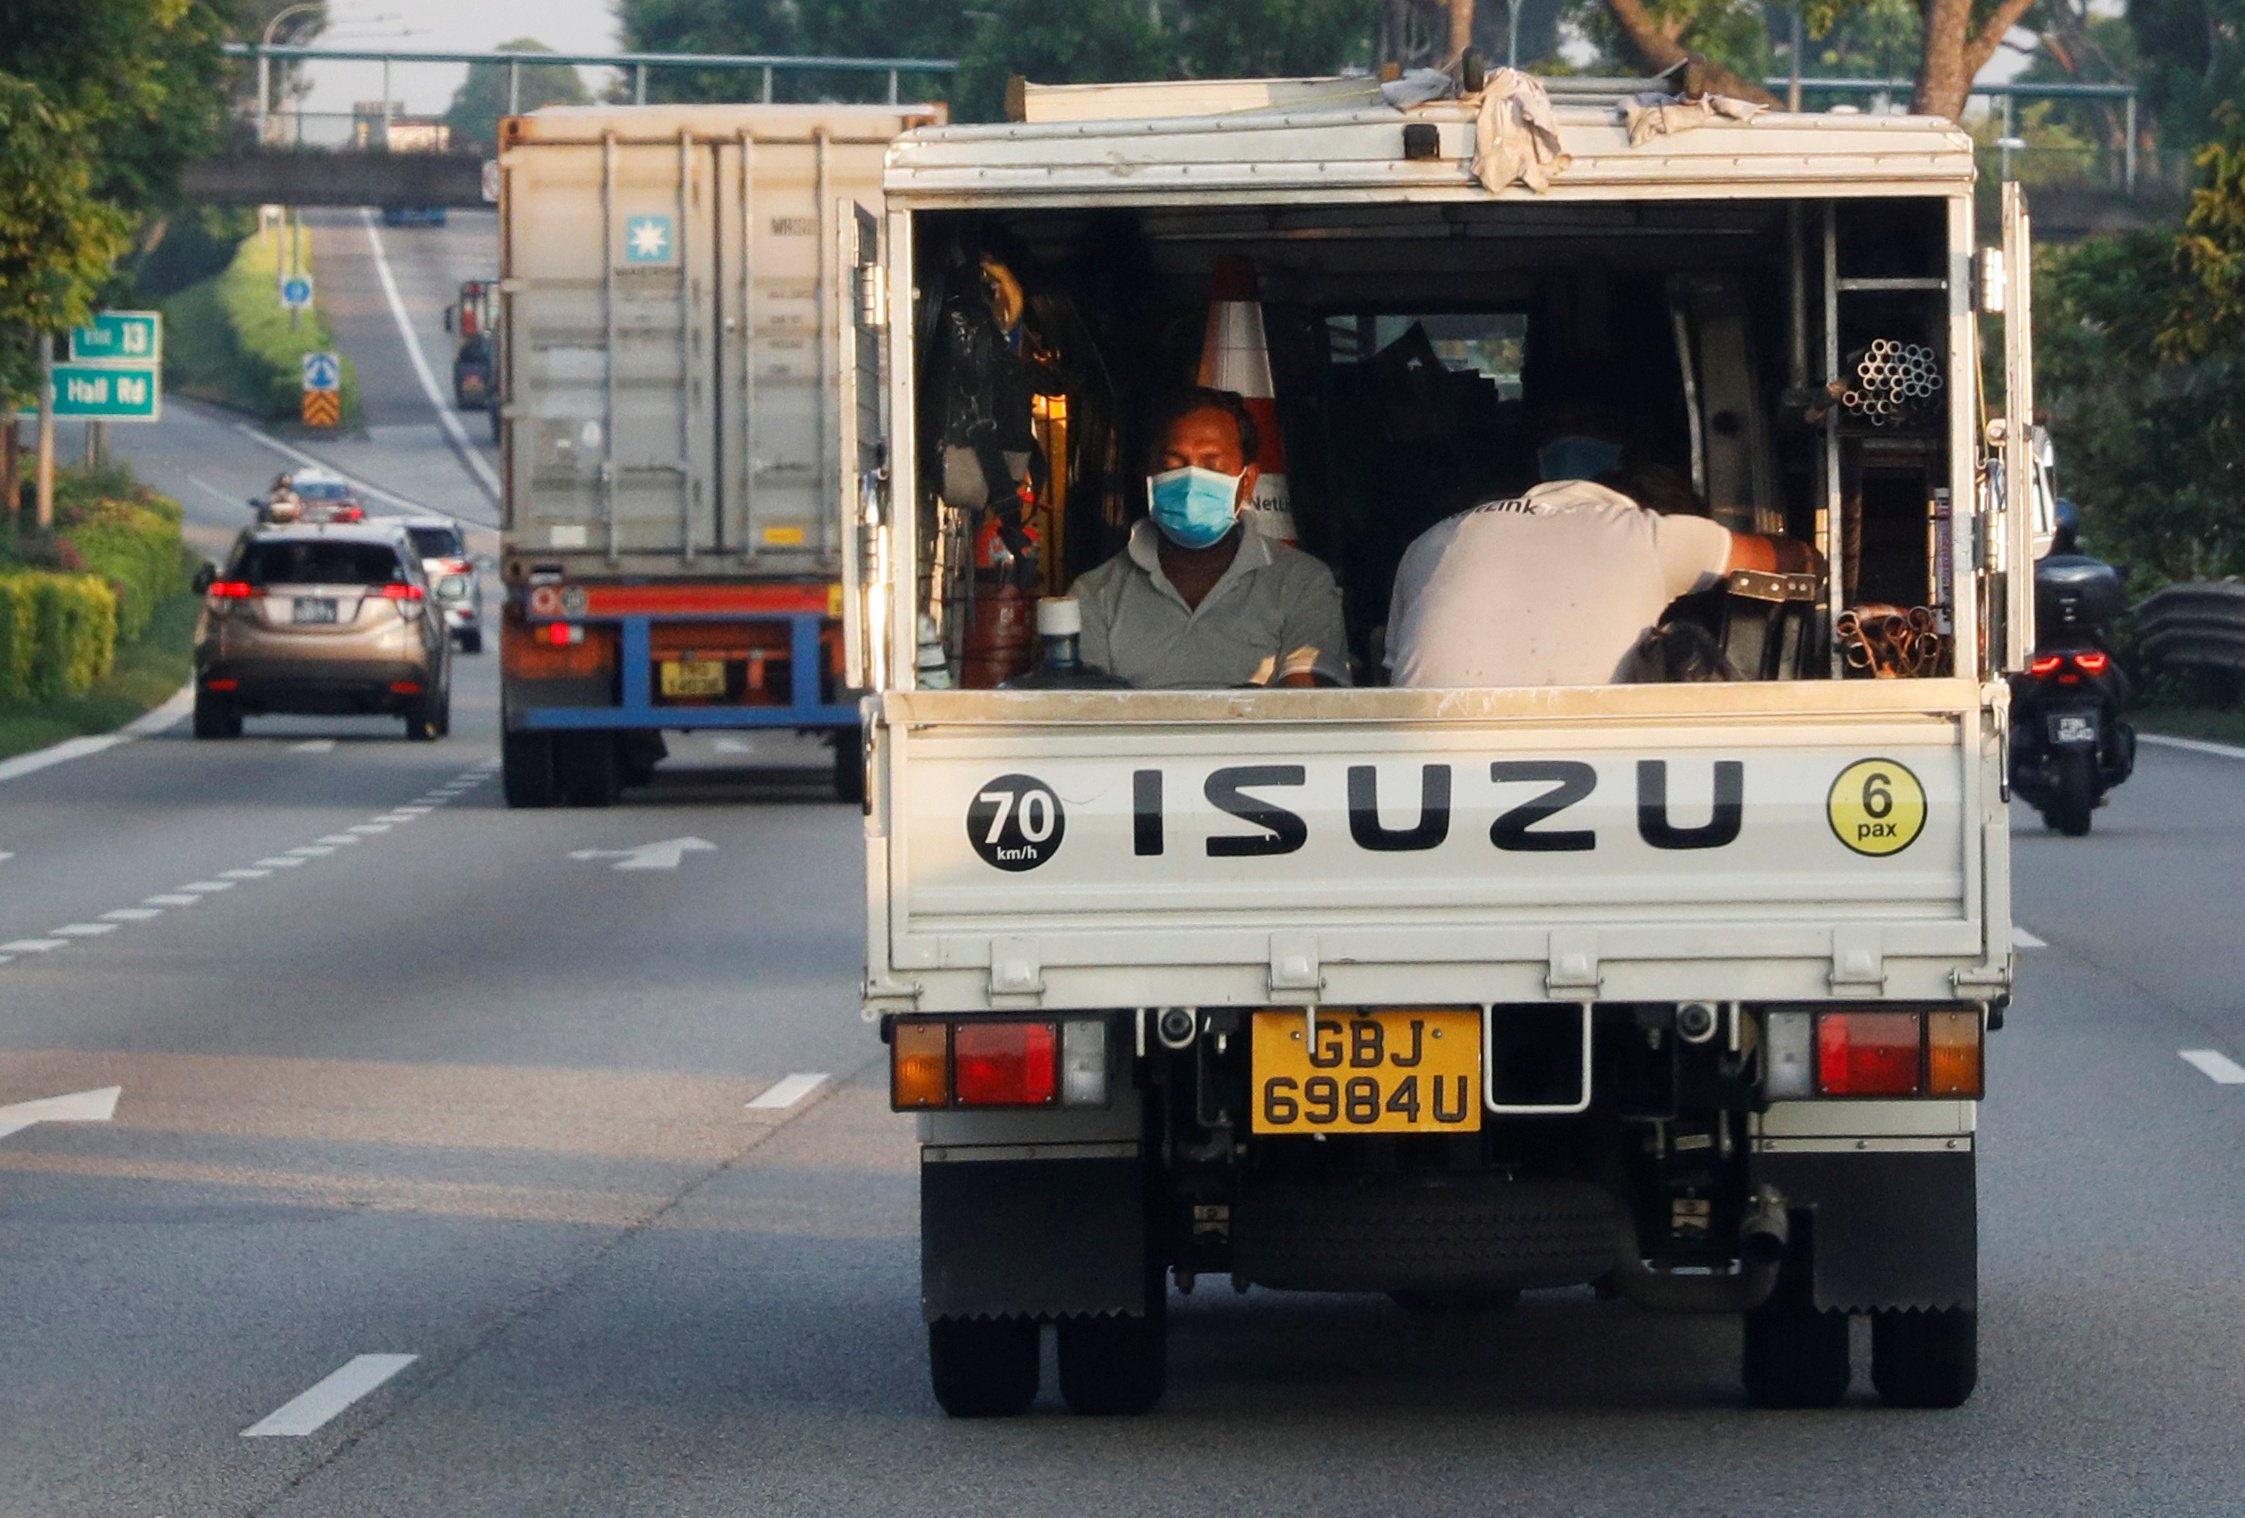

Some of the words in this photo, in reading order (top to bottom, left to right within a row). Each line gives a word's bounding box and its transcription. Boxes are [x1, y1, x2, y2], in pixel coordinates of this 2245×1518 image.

[122, 322, 147, 353] 13
[68, 377, 108, 404] Hall
[117, 377, 146, 404] Rd
[980, 789, 1055, 844] 70
[1133, 760, 1743, 857] ISUZU
[1863, 772, 1893, 819] 6
[997, 845, 1037, 861] km/h
[1857, 823, 1897, 842] pax
[1309, 1020, 1425, 1068] GBJ
[1264, 1075, 1468, 1125] 6984U
